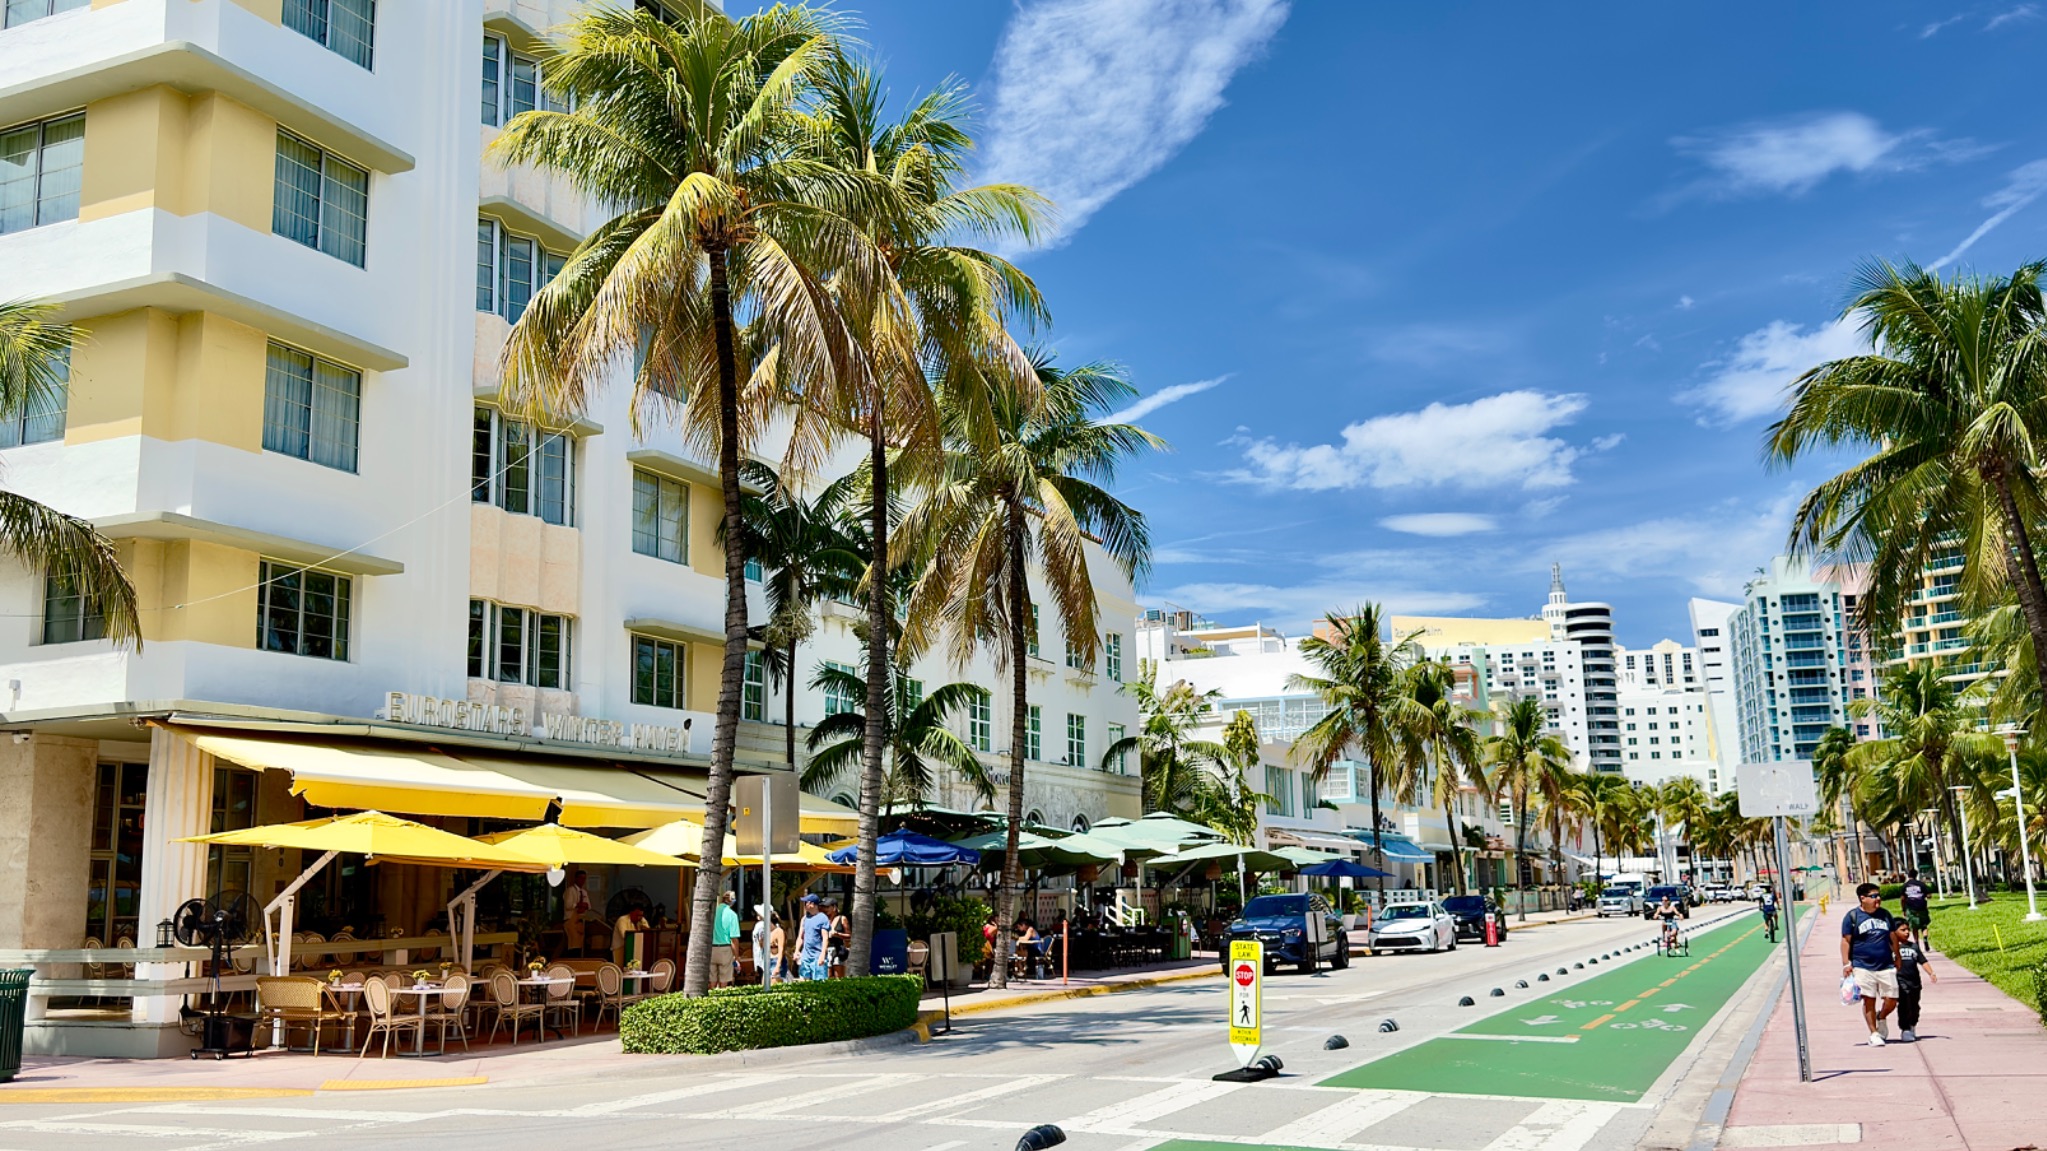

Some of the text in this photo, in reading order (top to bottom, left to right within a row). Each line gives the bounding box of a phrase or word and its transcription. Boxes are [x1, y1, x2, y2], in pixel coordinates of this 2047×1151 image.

[386, 691, 527, 735] EUROSTARS
[1235, 943, 1254, 951] STATE
[1236, 970, 1253, 980] STOP
